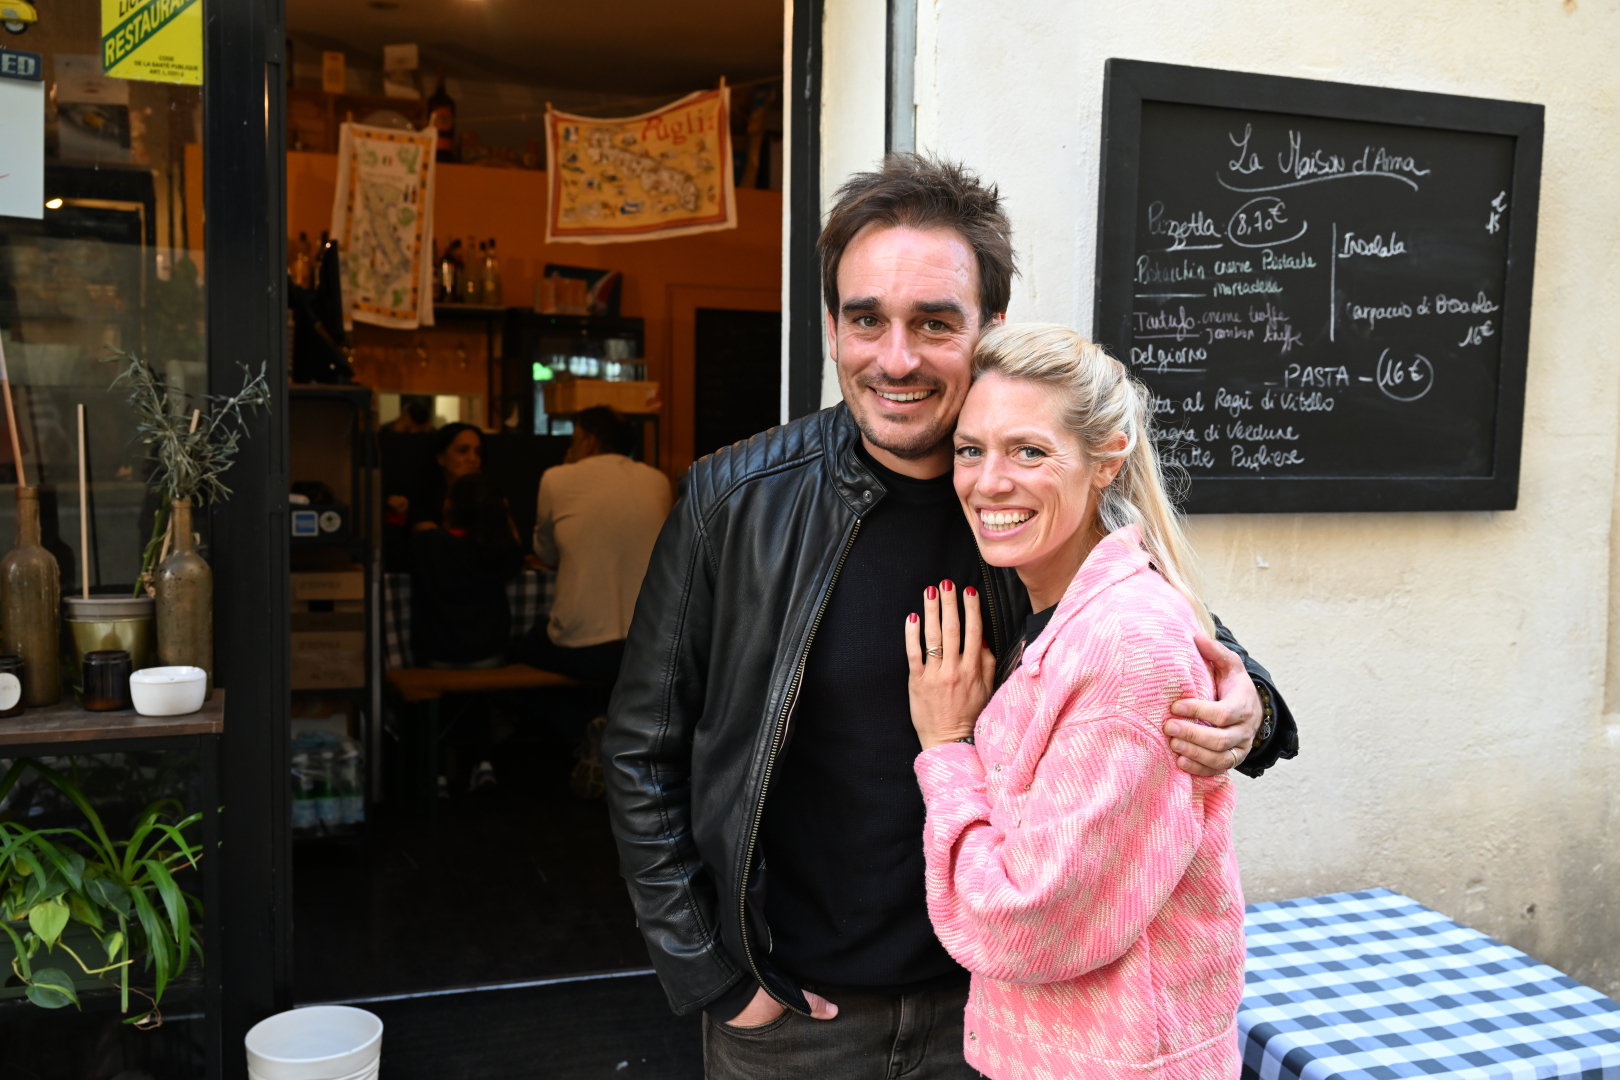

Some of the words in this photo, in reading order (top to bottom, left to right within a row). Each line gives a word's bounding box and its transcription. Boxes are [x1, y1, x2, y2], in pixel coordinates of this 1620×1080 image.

[1229, 122, 1264, 175] La
[1278, 130, 1346, 180] Maison
[1417, 296, 1432, 316] di
[1284, 363, 1350, 389] PASTA
[1182, 391, 1205, 413] al
[1261, 389, 1276, 411] di
[1204, 424, 1221, 442] di
